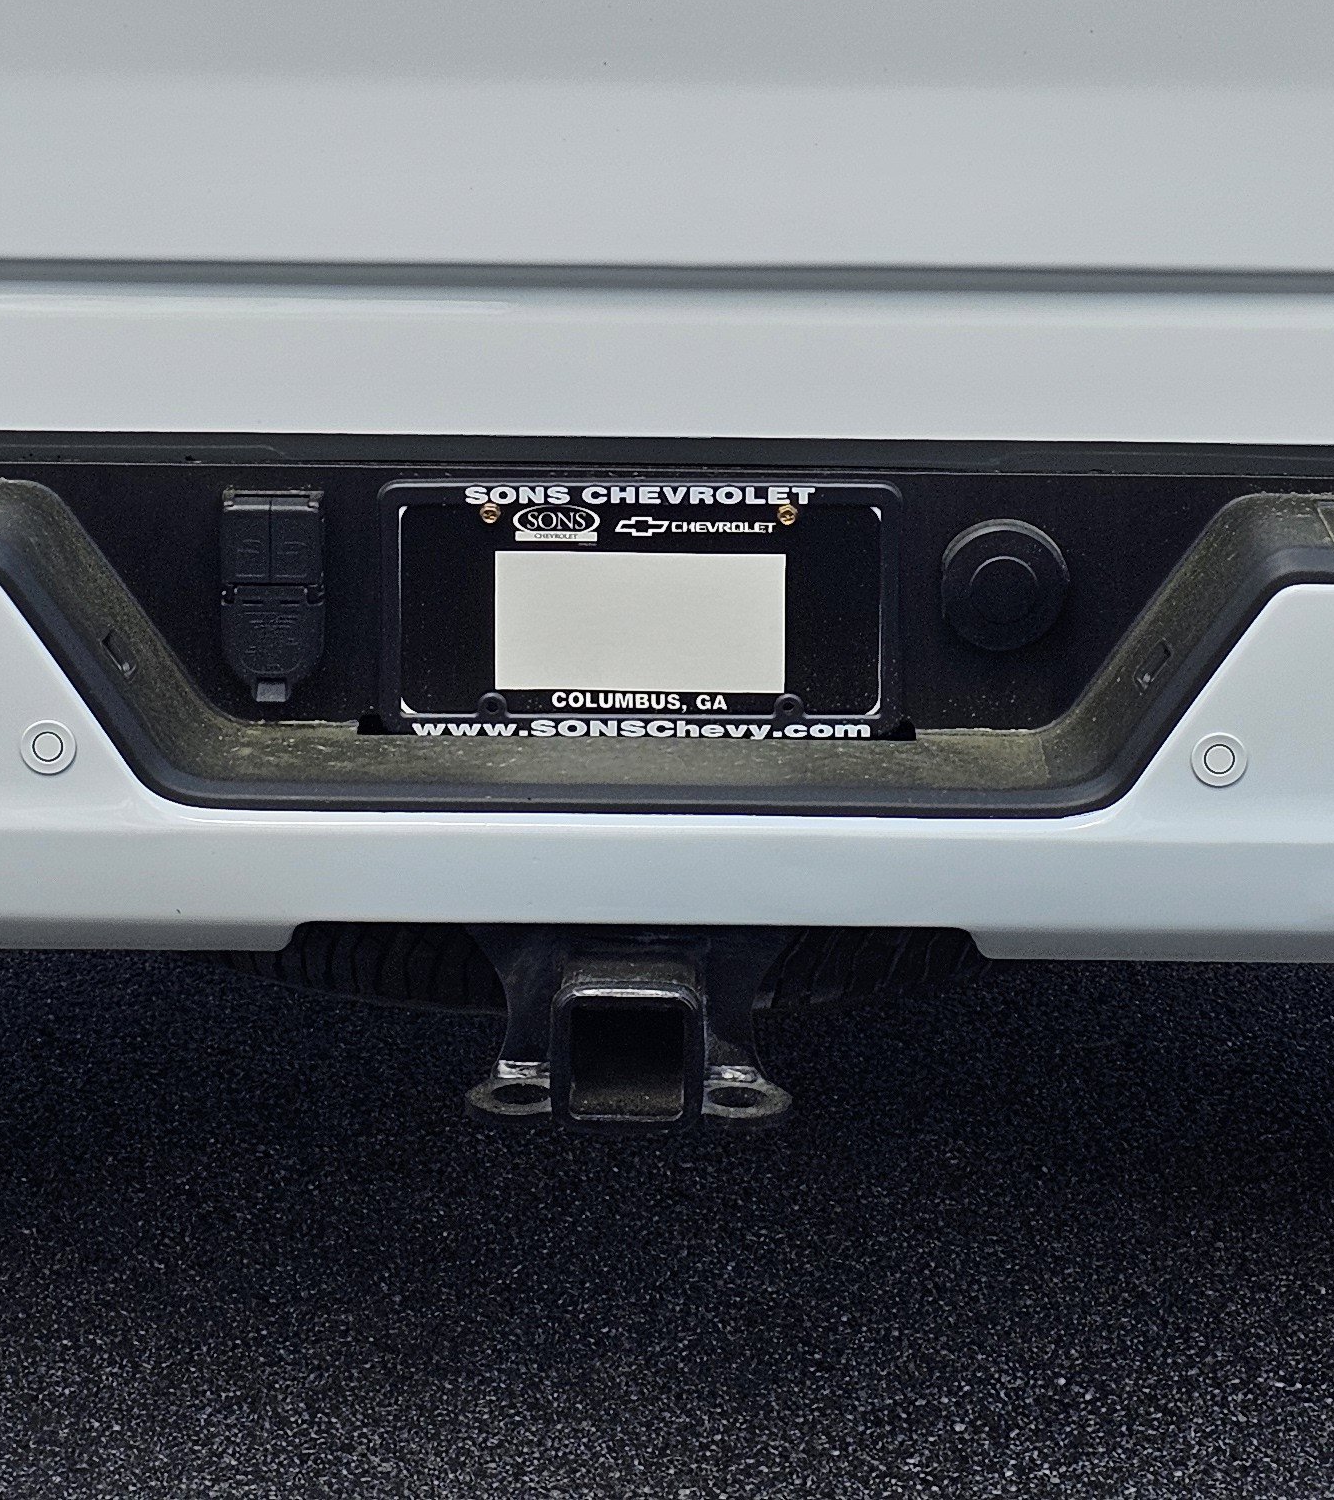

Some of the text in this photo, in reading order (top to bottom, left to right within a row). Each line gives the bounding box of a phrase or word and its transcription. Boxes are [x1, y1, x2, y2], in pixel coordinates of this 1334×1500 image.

[464, 486, 816, 505] SONS CHEVROLET
[526, 511, 587, 530] SONS
[671, 521, 776, 533] CHEVROLET
[551, 691, 728, 713] COLUMBUS, GA
[412, 720, 872, 740] www.SONSChevy.com
